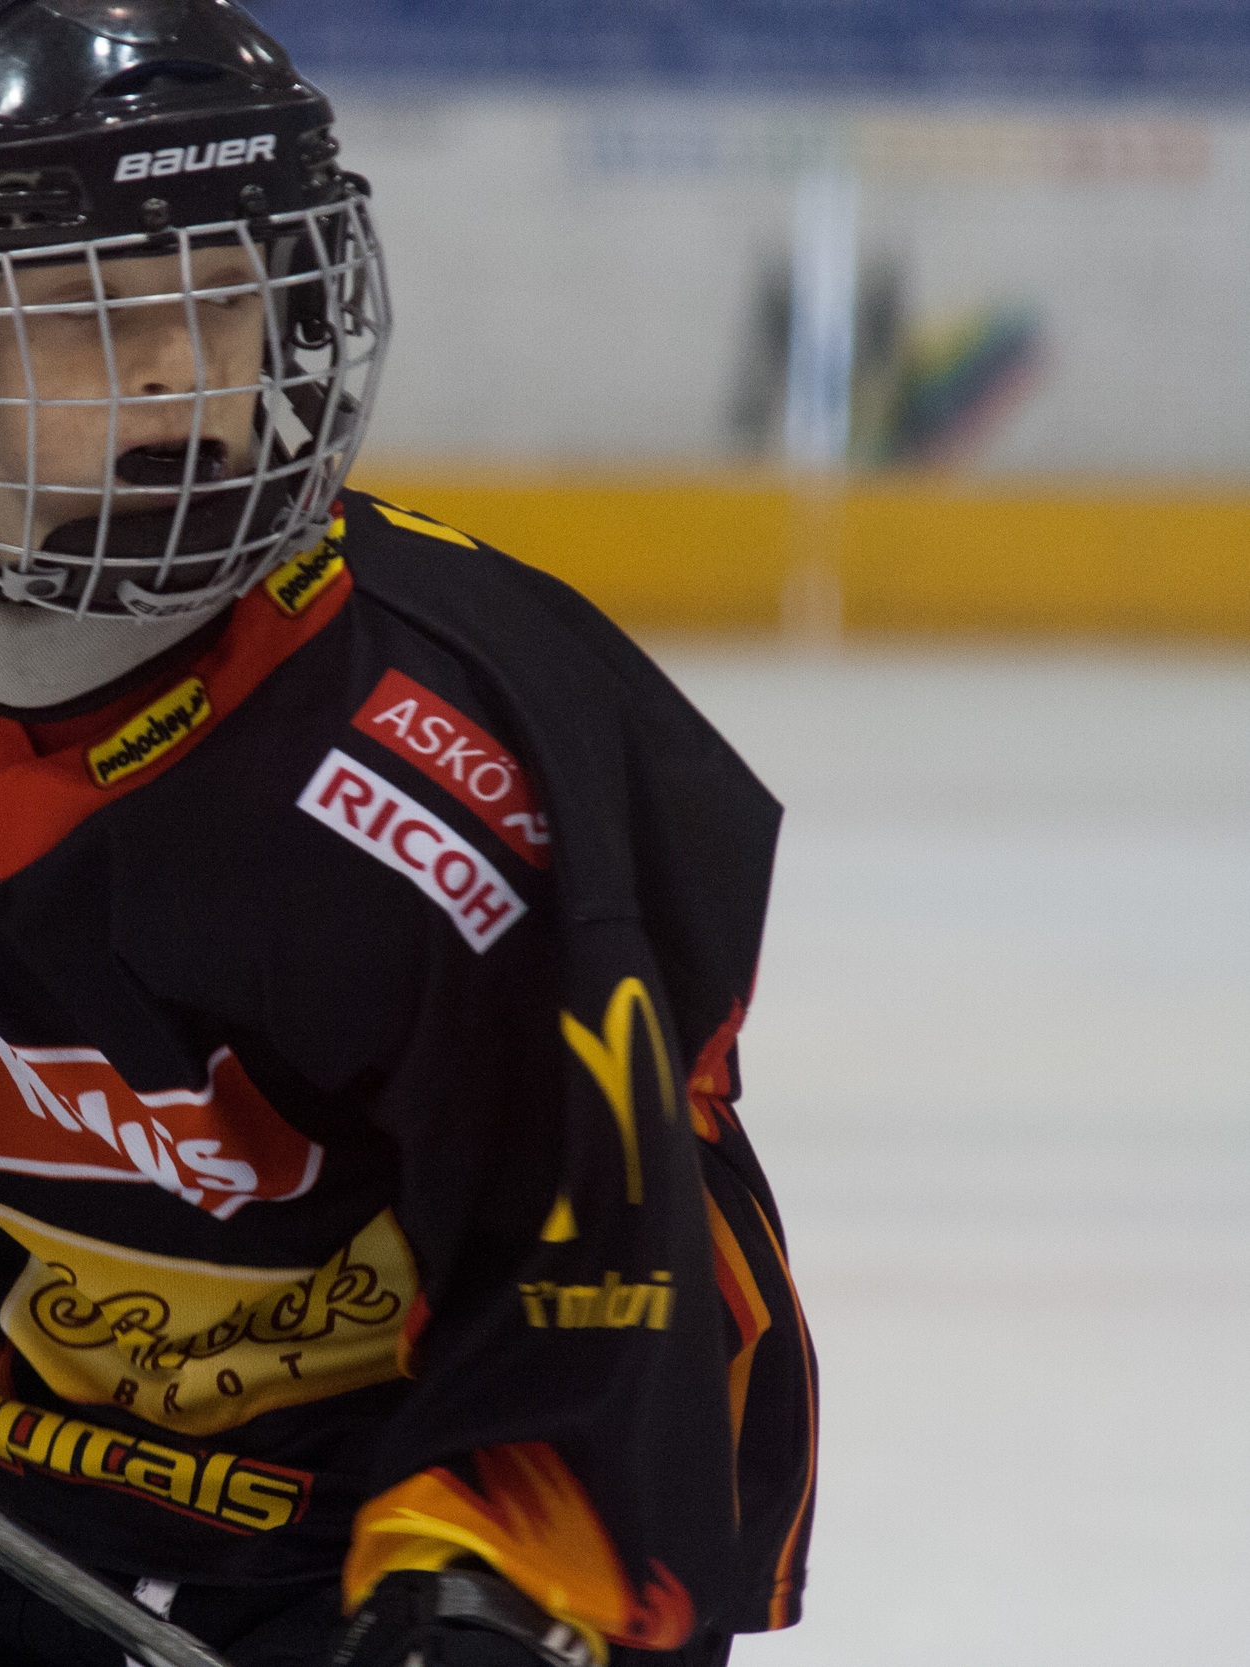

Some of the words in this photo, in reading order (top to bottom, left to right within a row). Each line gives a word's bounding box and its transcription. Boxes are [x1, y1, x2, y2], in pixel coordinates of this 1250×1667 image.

[114, 133, 277, 183] BAUER
[372, 698, 518, 802] ASKÖ
[316, 765, 513, 938] RICOH
[112, 1352, 304, 1416] BROT
